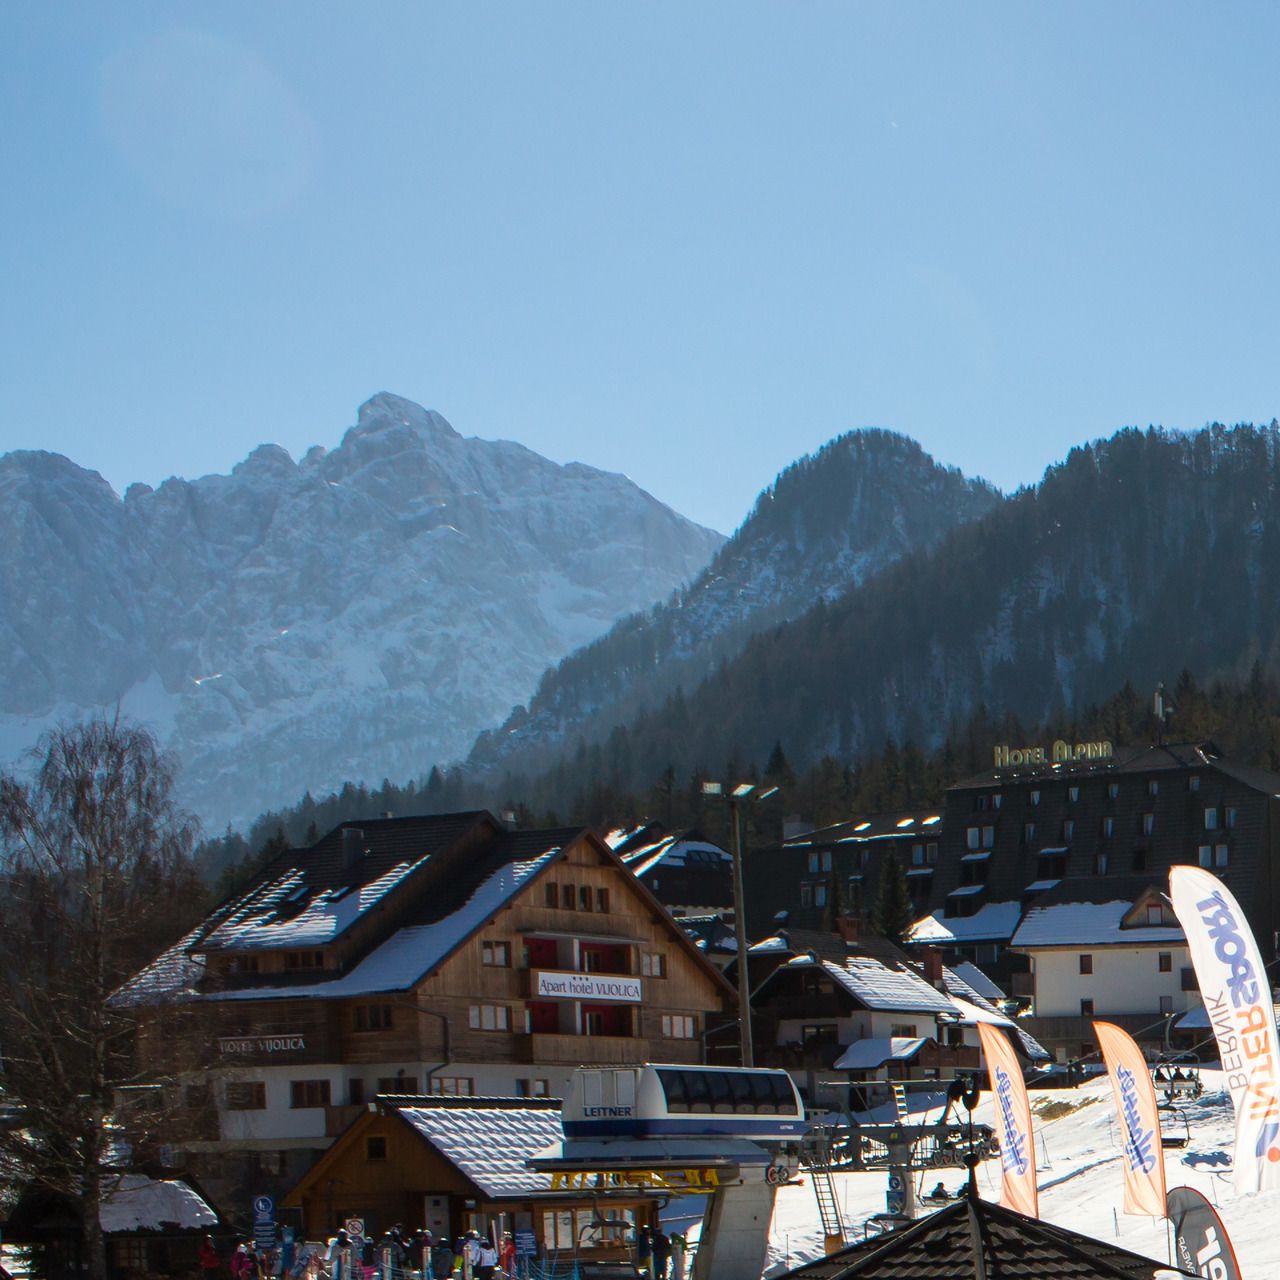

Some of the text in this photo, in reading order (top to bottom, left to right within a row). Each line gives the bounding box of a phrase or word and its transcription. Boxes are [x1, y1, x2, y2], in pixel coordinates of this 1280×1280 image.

[541, 979, 566, 995] Apart
[569, 981, 594, 995] hotel
[584, 1106, 632, 1118] LEITNER
